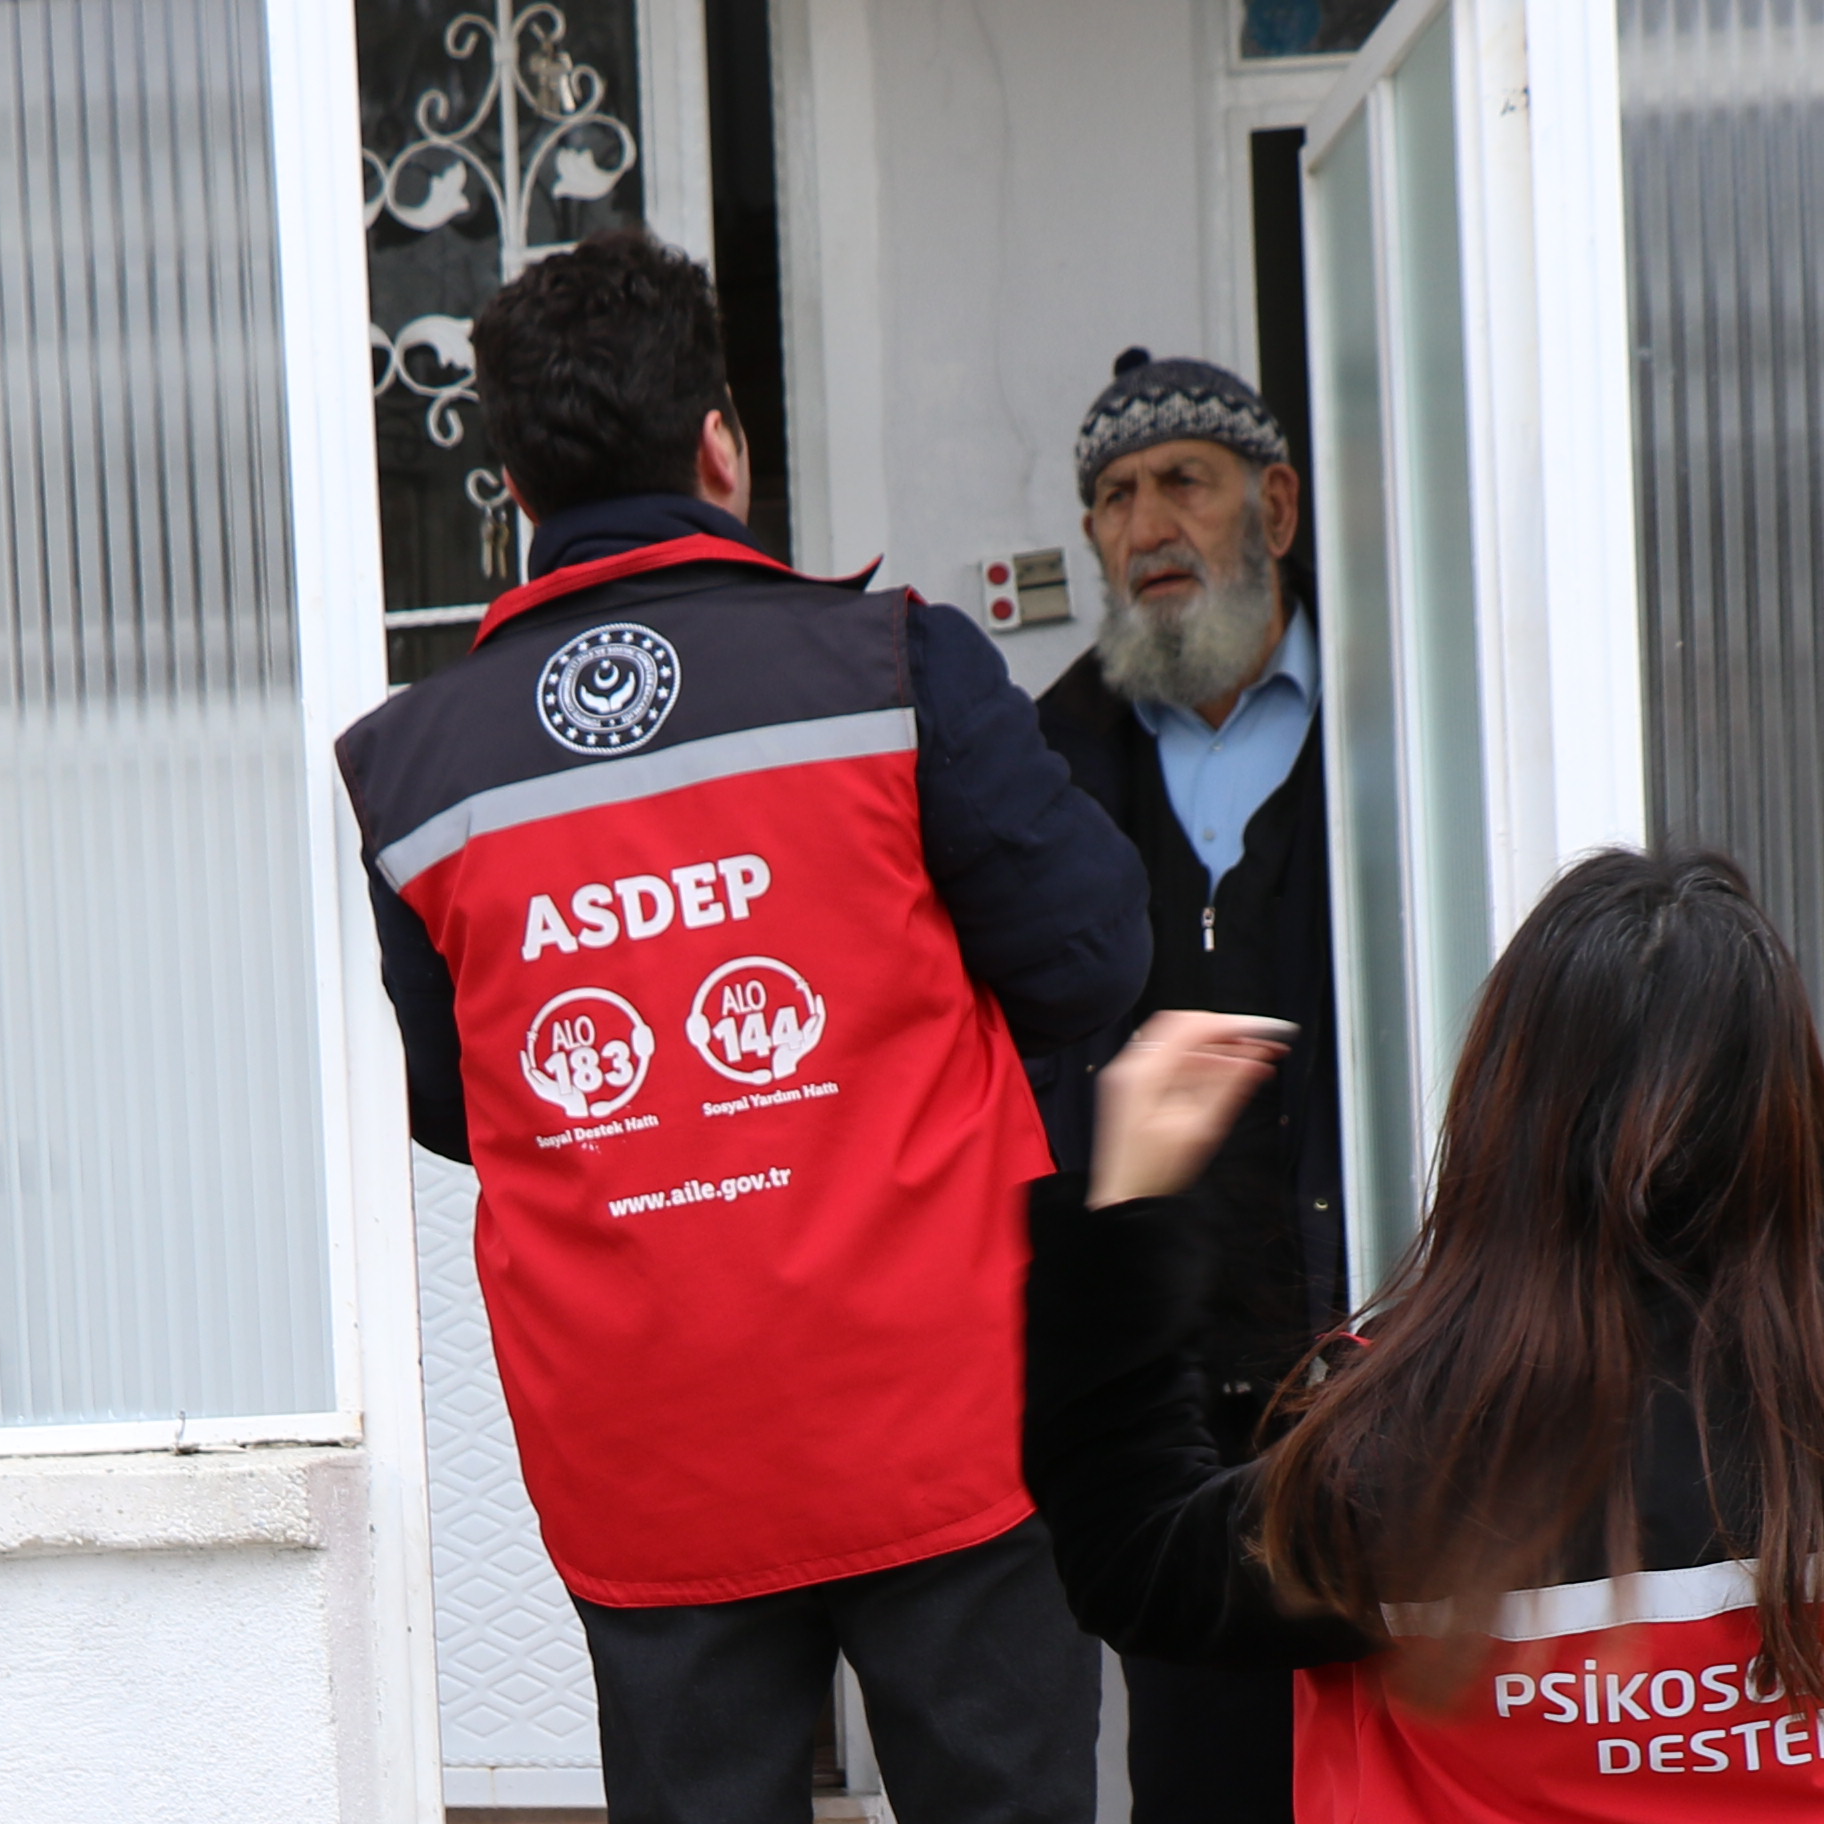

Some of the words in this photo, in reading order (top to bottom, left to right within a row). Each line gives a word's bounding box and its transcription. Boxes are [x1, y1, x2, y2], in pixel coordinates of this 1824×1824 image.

[521, 853, 772, 961] ASDEP
[722, 980, 767, 1016] ALO
[552, 1015, 596, 1051] ALO
[713, 1006, 804, 1063] 144
[544, 1039, 635, 1096] 183
[702, 1096, 750, 1116] Sosyal
[749, 1089, 802, 1109] Yardım
[802, 1082, 839, 1098] Hattı
[535, 1129, 573, 1149] Sosyal
[573, 1120, 624, 1142] Destek
[624, 1114, 659, 1132] Hattı
[608, 1166, 792, 1218] www.aile.gov.tr
